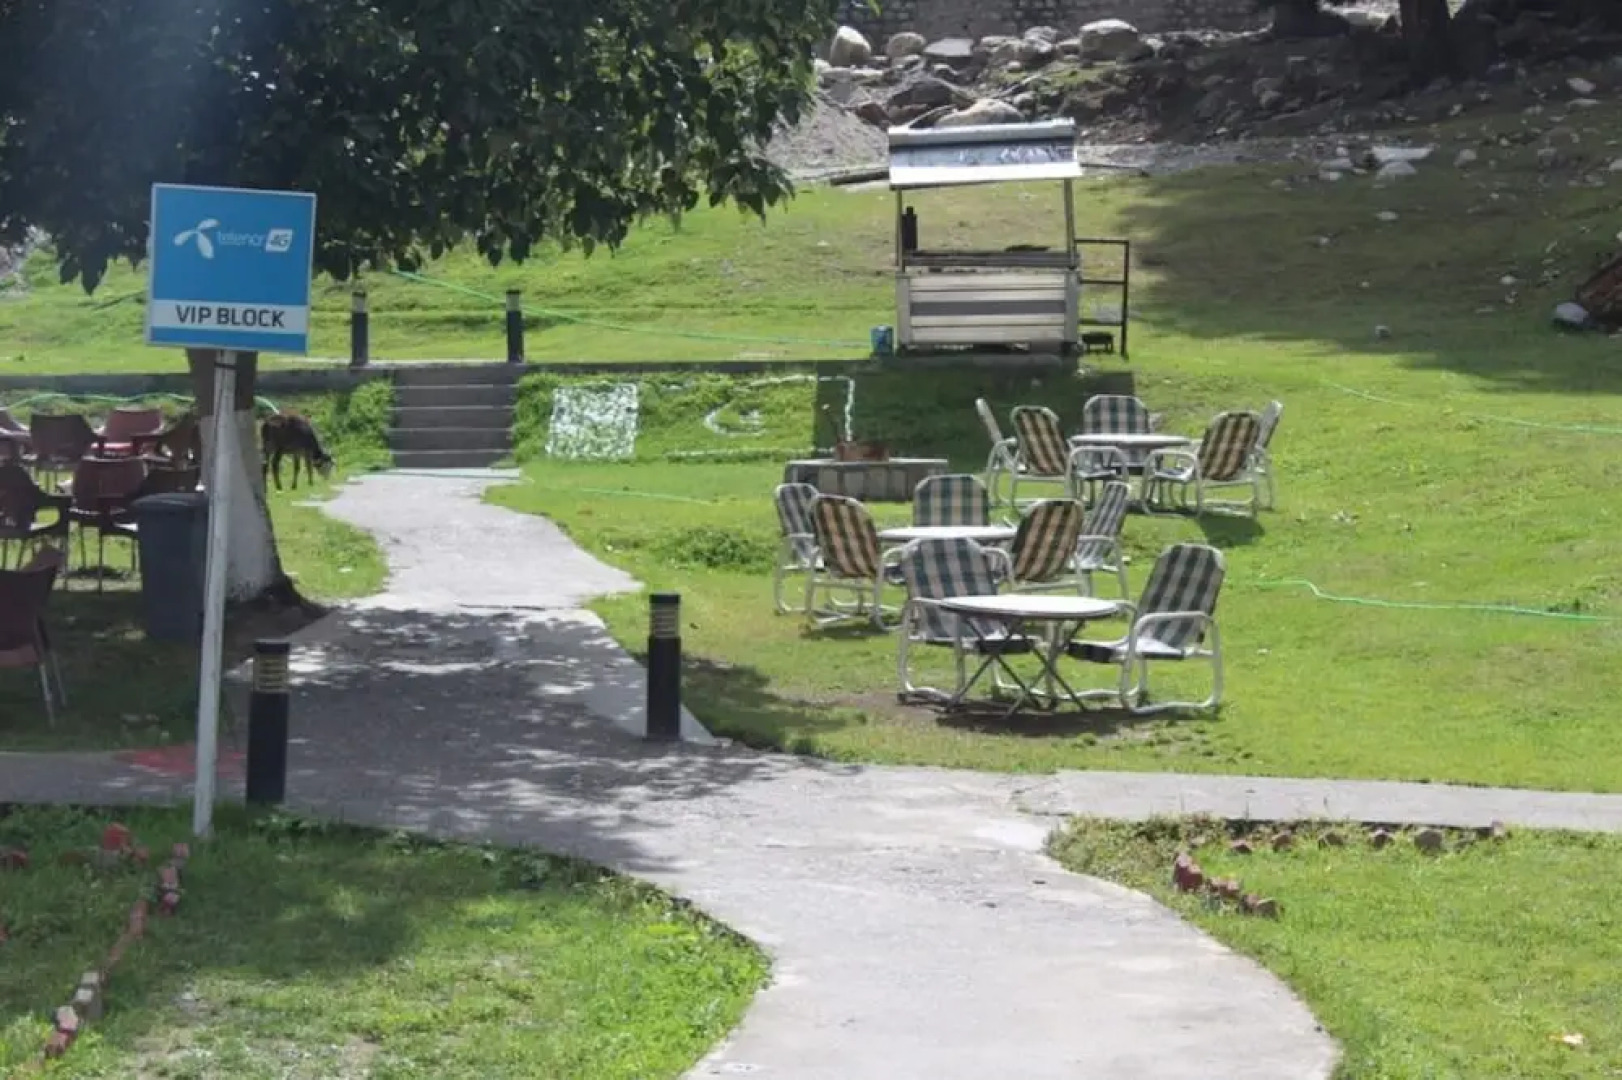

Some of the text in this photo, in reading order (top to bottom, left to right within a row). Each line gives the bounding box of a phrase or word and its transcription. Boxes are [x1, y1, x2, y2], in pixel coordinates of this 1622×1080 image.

[268, 232, 289, 247] 4G
[176, 305, 285, 328] VIP BLOCK
